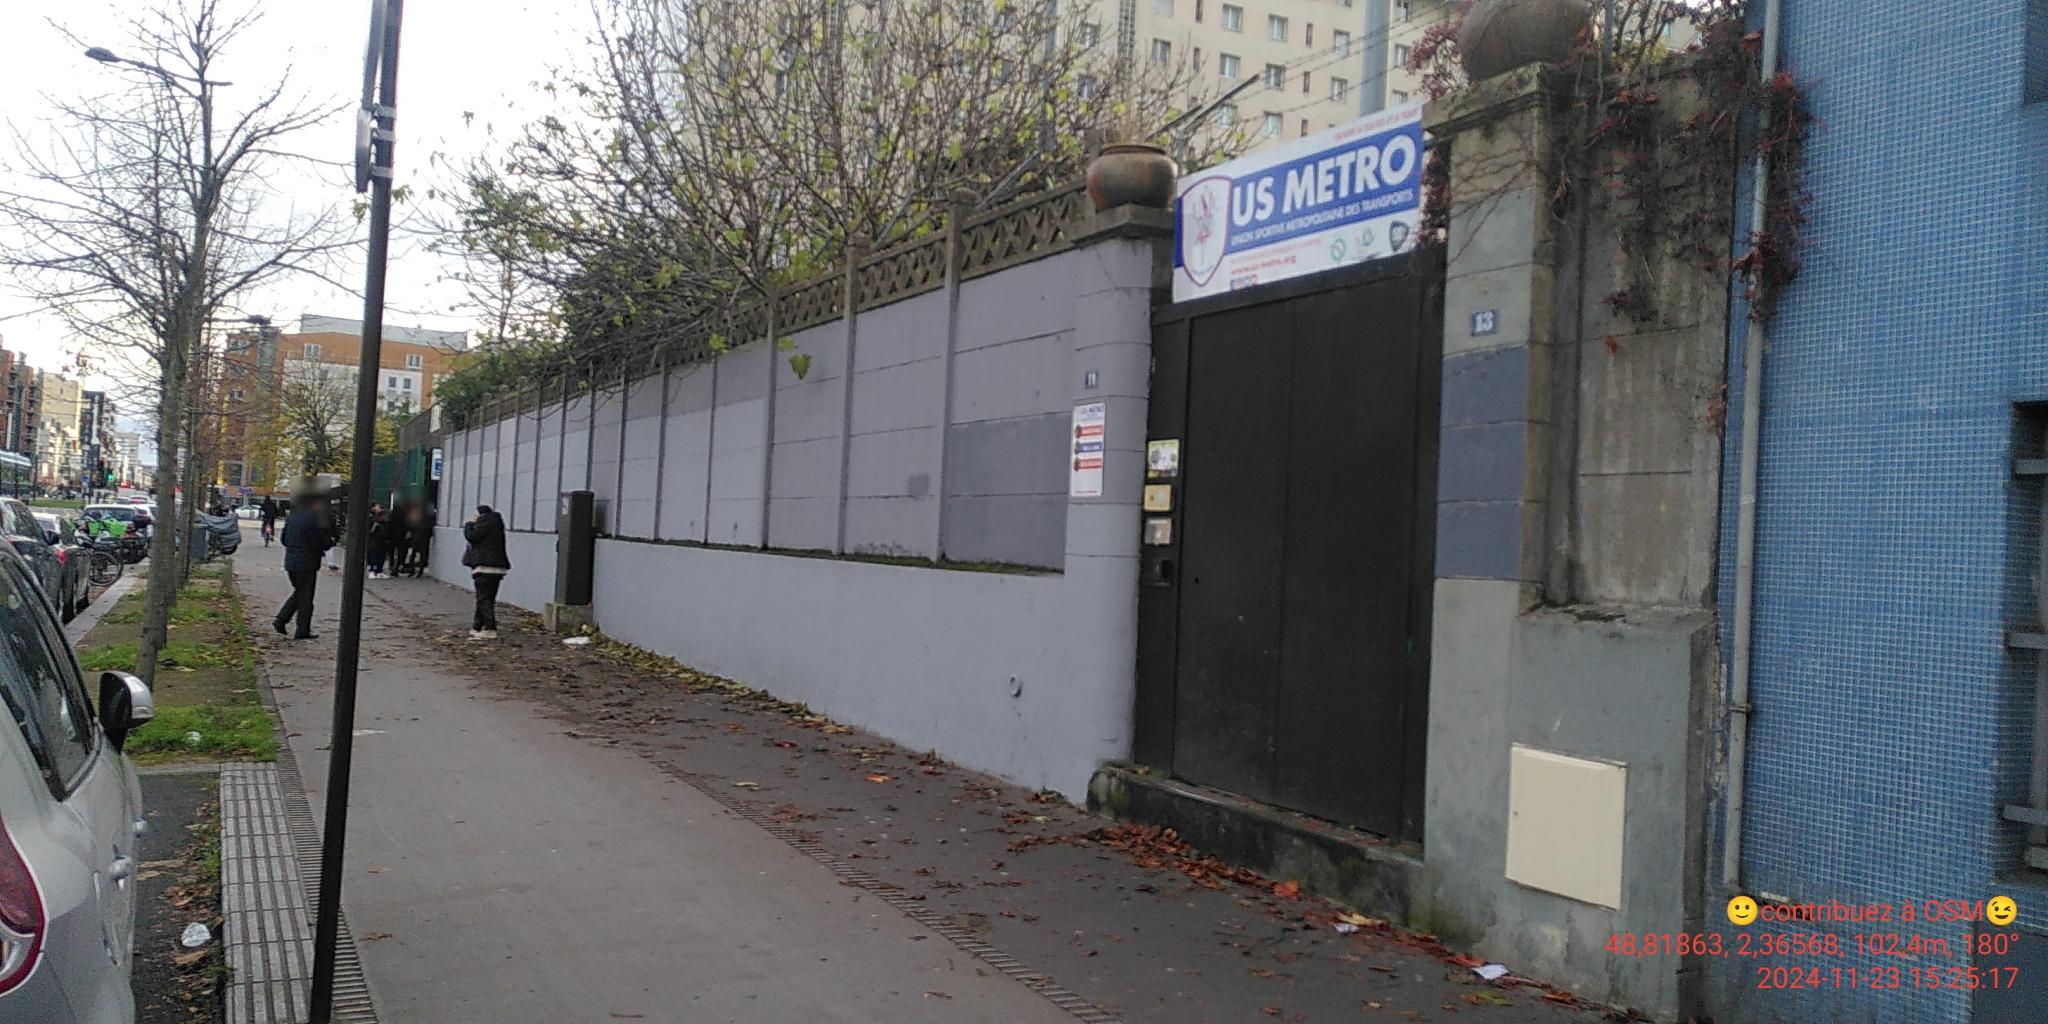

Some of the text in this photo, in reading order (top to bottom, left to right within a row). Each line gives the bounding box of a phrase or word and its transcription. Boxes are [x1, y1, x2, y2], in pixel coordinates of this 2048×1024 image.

[1232, 134, 1416, 226] US METRO
[1231, 231, 1254, 246] UNION
[1255, 223, 1285, 241] SPORTIVE
[1345, 203, 1361, 218] DES
[1362, 190, 1414, 214] TRANSPORTS
[1475, 311, 1494, 332] 13
